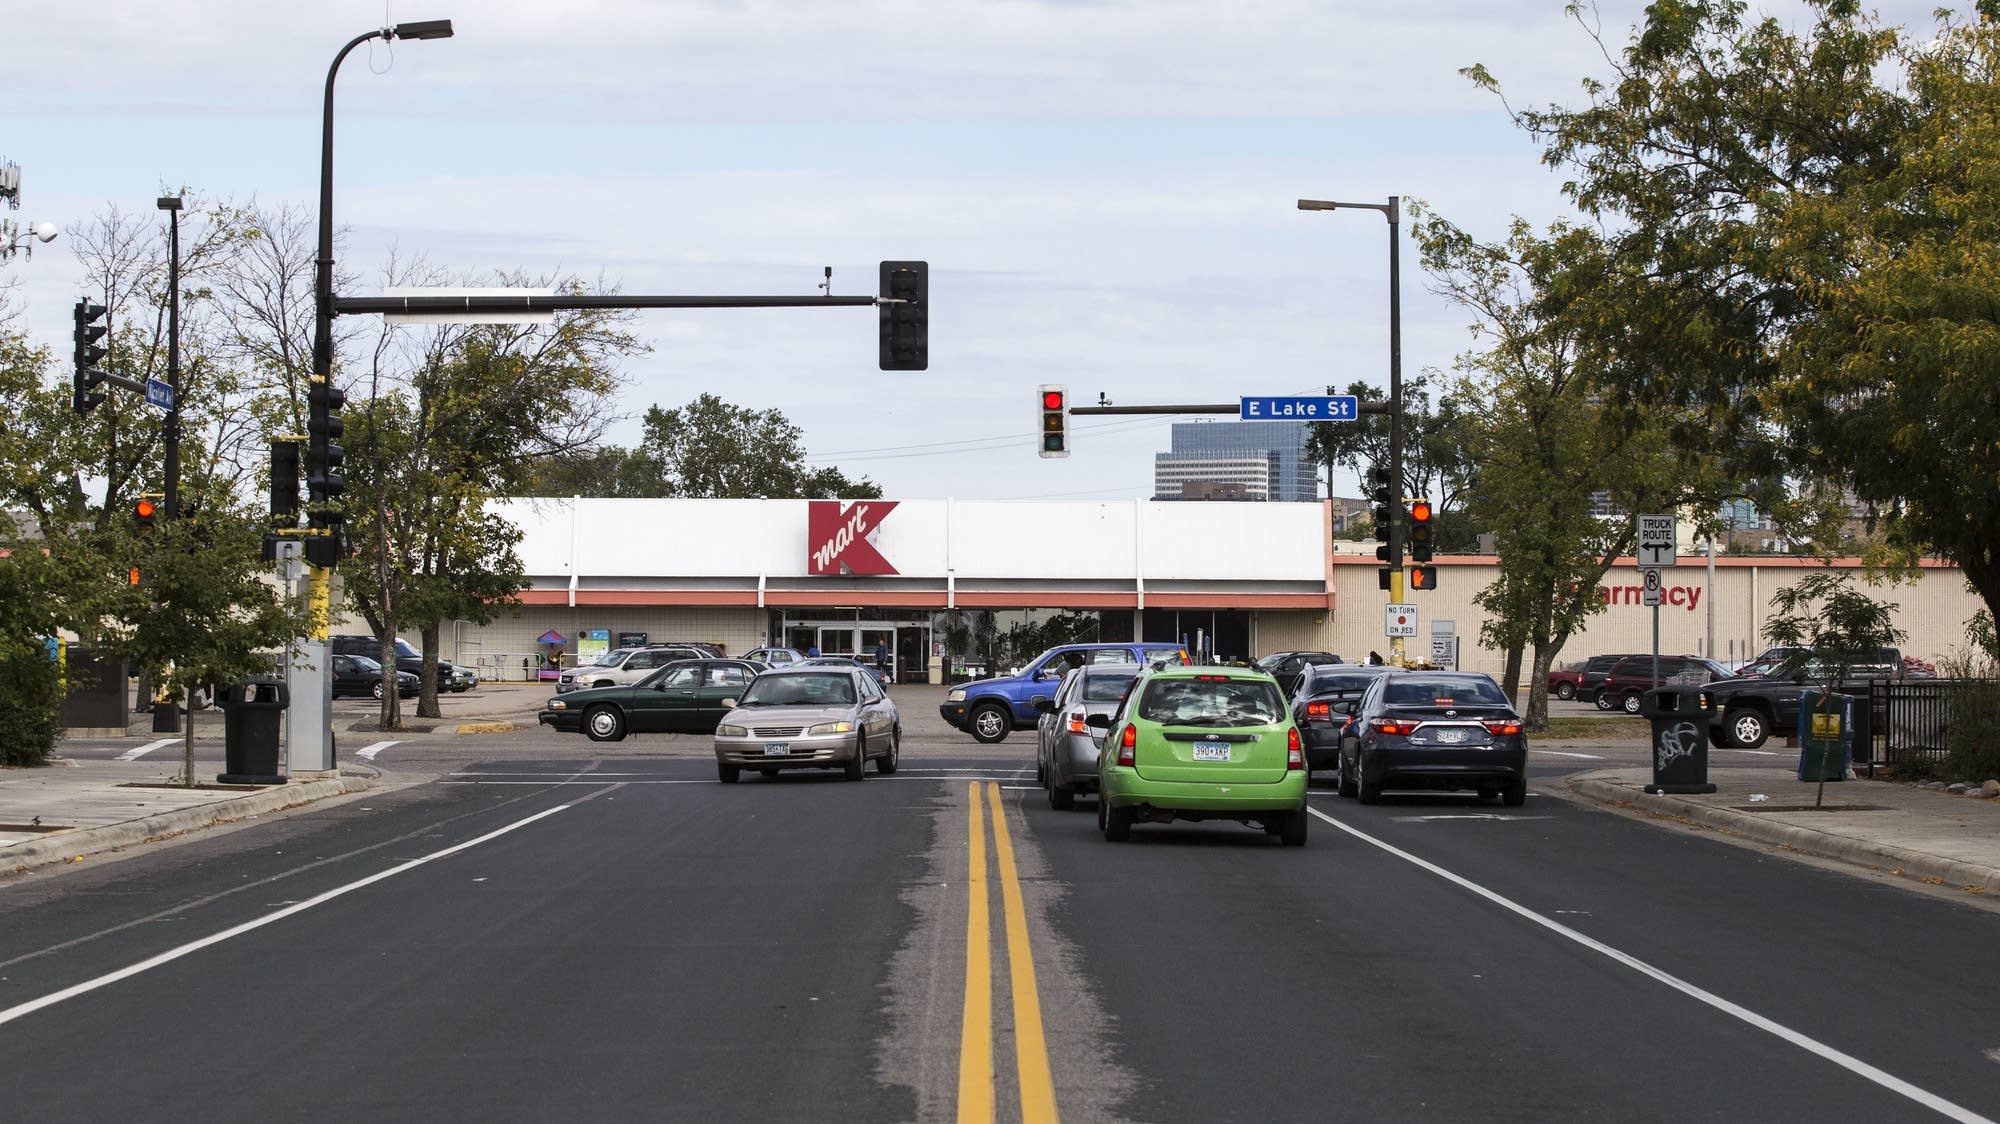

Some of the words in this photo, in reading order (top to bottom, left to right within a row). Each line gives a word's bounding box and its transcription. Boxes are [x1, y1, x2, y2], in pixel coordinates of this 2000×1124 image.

[1249, 401, 1260, 416] E
[1271, 401, 1317, 416] Lake
[1327, 401, 1349, 416] St
[1643, 519, 1671, 529] TRUCK
[813, 505, 869, 571] mart
[1643, 530, 1671, 540] ROUTE
[1399, 606, 1415, 614] TURN
[1401, 626, 1413, 634] RED
